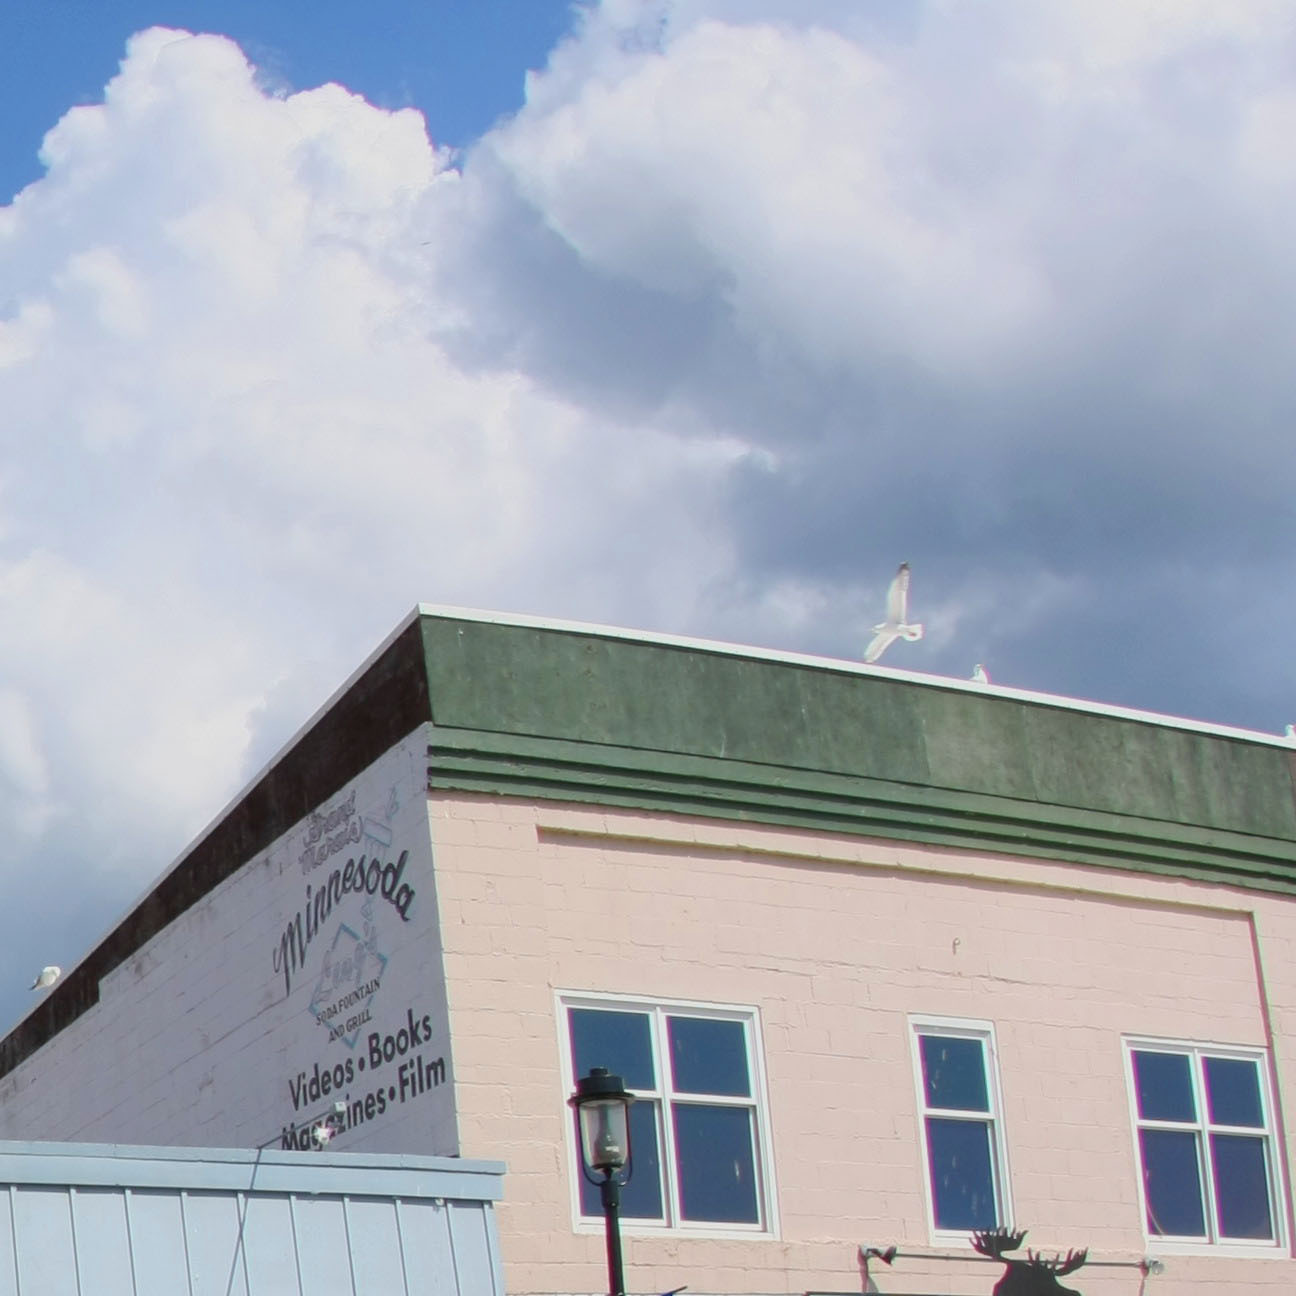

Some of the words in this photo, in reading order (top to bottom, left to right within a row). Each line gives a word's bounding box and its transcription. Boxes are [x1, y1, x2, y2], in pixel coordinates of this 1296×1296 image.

[273, 850, 415, 997] Minnesoda
[316, 1005, 339, 1026] SODA
[338, 977, 381, 1014] FOUNTAIN
[328, 1023, 346, 1044] AND
[346, 1009, 372, 1033] GRILL
[289, 1058, 354, 1111] Videos
[368, 1008, 433, 1070] Books
[398, 1055, 446, 1103] Film
